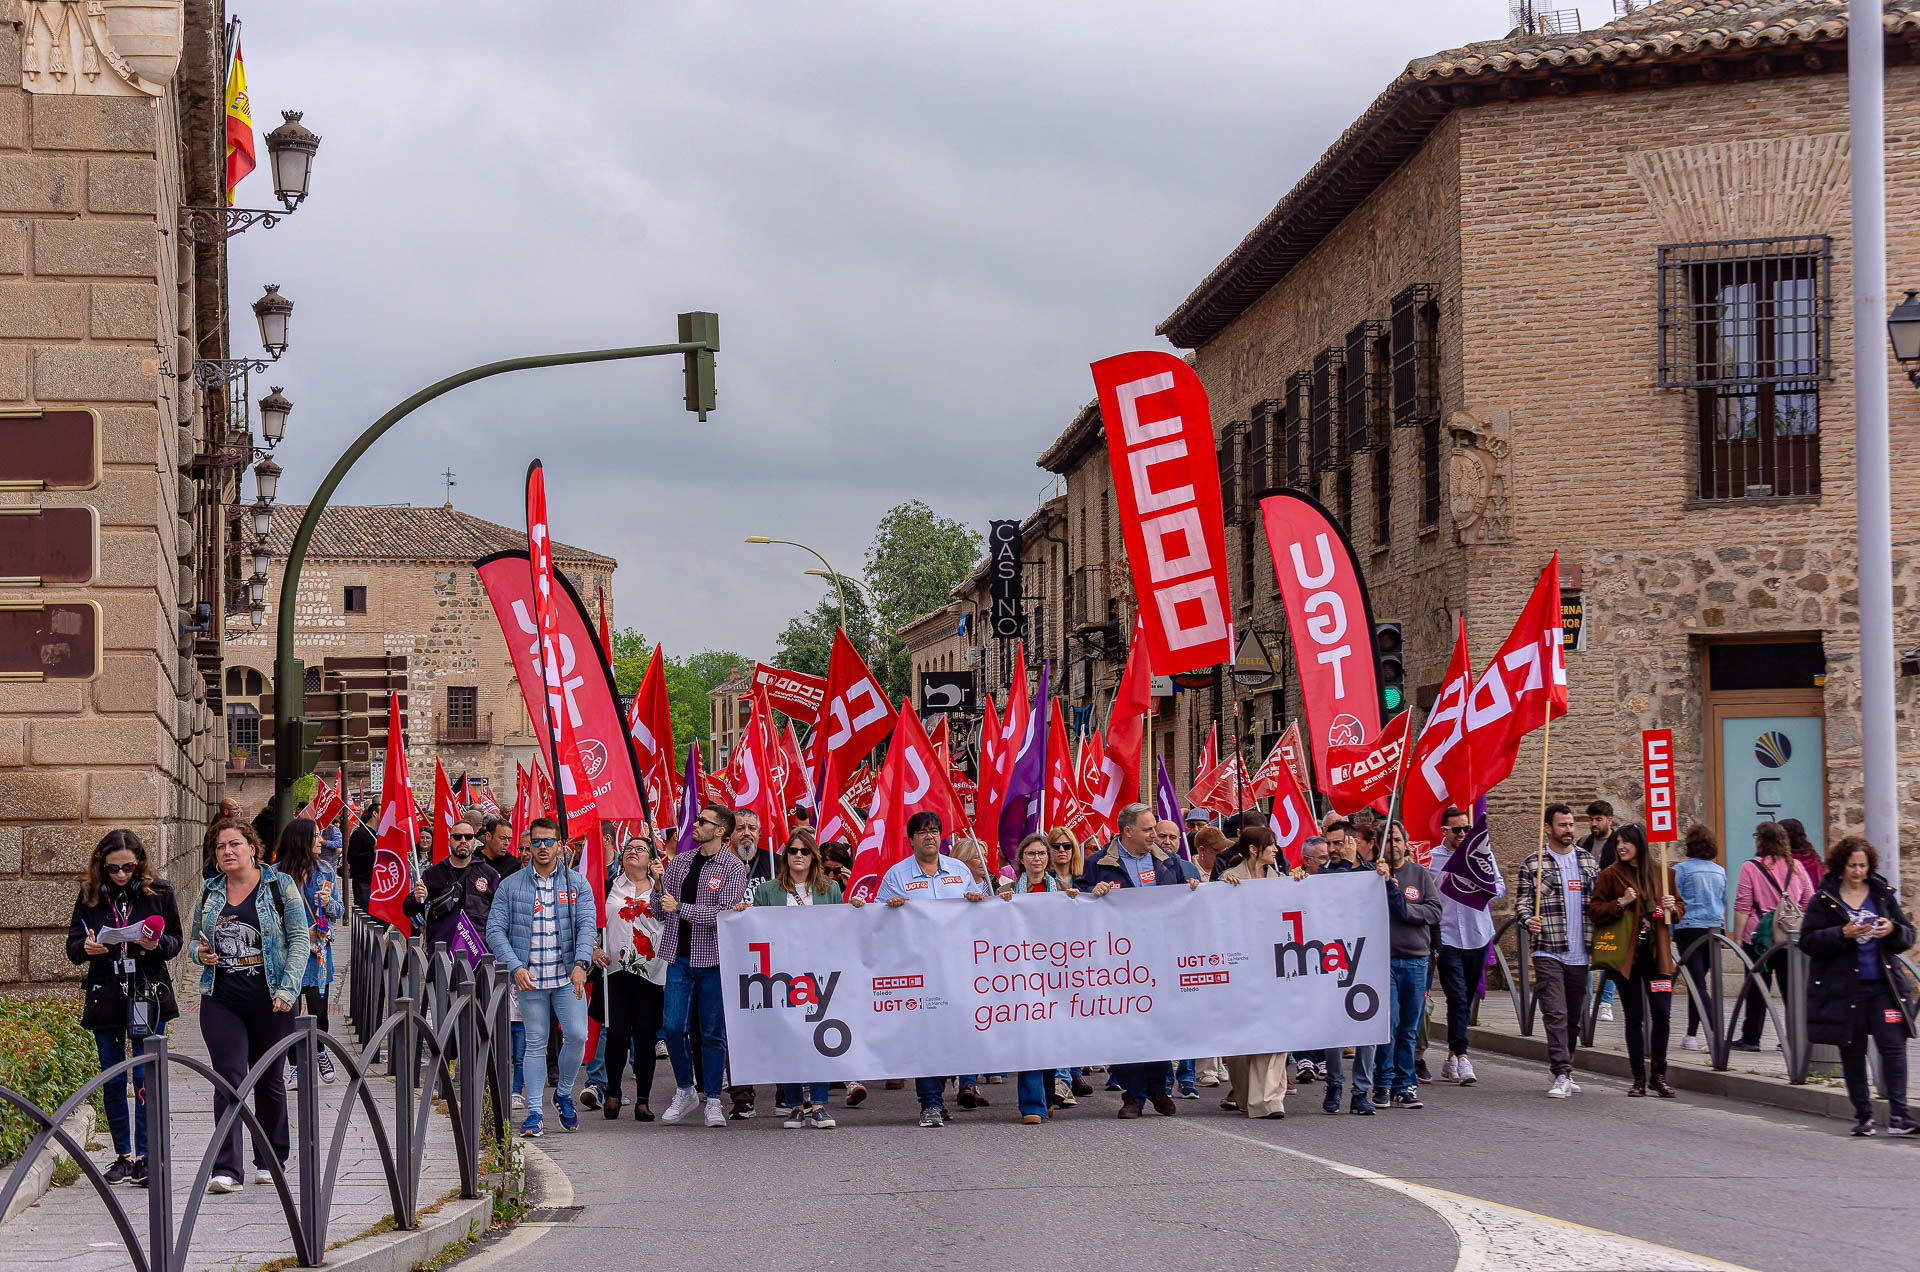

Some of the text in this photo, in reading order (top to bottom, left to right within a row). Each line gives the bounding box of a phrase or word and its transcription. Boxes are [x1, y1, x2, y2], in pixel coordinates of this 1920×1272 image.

[1115, 370, 1228, 652] CCOO
[996, 523, 1019, 636] CASINO
[1239, 657, 1265, 665] DELTA
[1648, 739, 1672, 831] CCOO
[568, 801, 596, 820] Mancha
[905, 882, 920, 891] UGT
[973, 931, 1132, 967] Proteger lo
[1177, 955, 1207, 969] UGT
[875, 978, 908, 988] CCOO
[973, 960, 1157, 998] conquistado,
[1181, 973, 1214, 985] CCOO
[873, 999, 903, 1013] UGT
[974, 992, 1153, 1031] ganar futuro
